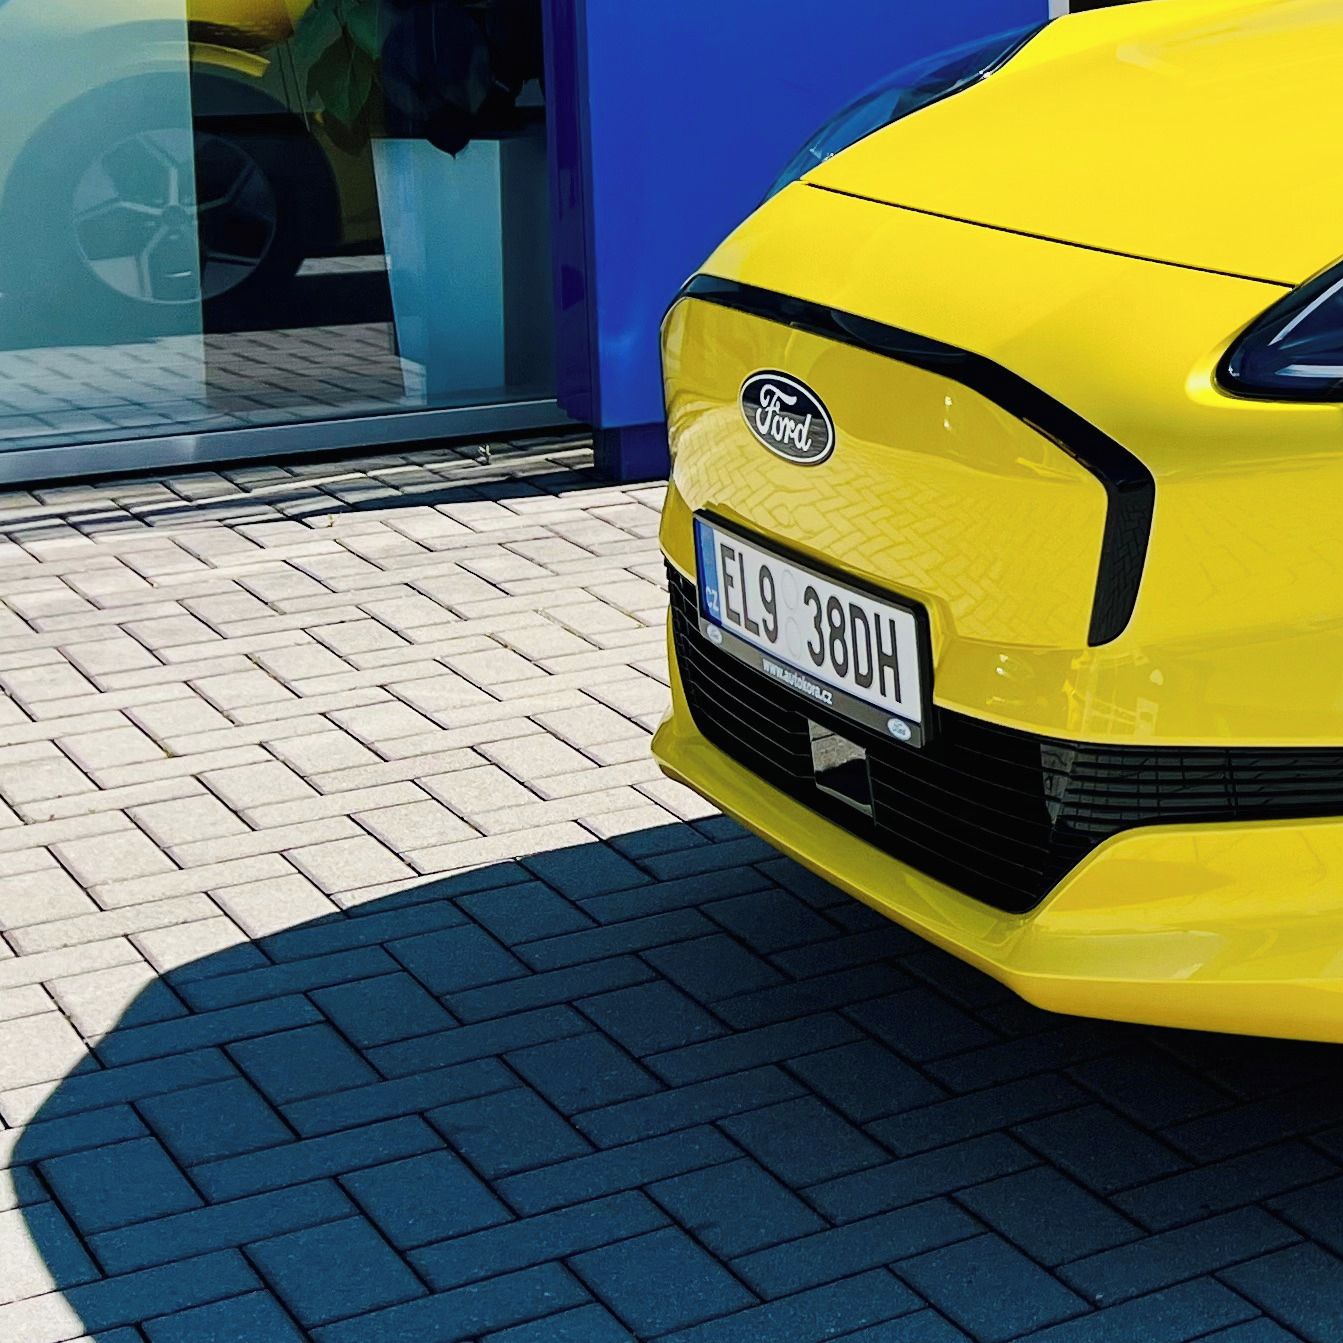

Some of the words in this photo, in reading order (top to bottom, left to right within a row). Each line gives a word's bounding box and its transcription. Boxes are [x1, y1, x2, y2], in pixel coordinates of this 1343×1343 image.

[756, 384, 812, 452] Ford
[706, 587, 719, 611] CZ
[720, 543, 779, 644] EL9
[803, 585, 902, 704] 38DH
[763, 658, 833, 706] www.autokora.cz
